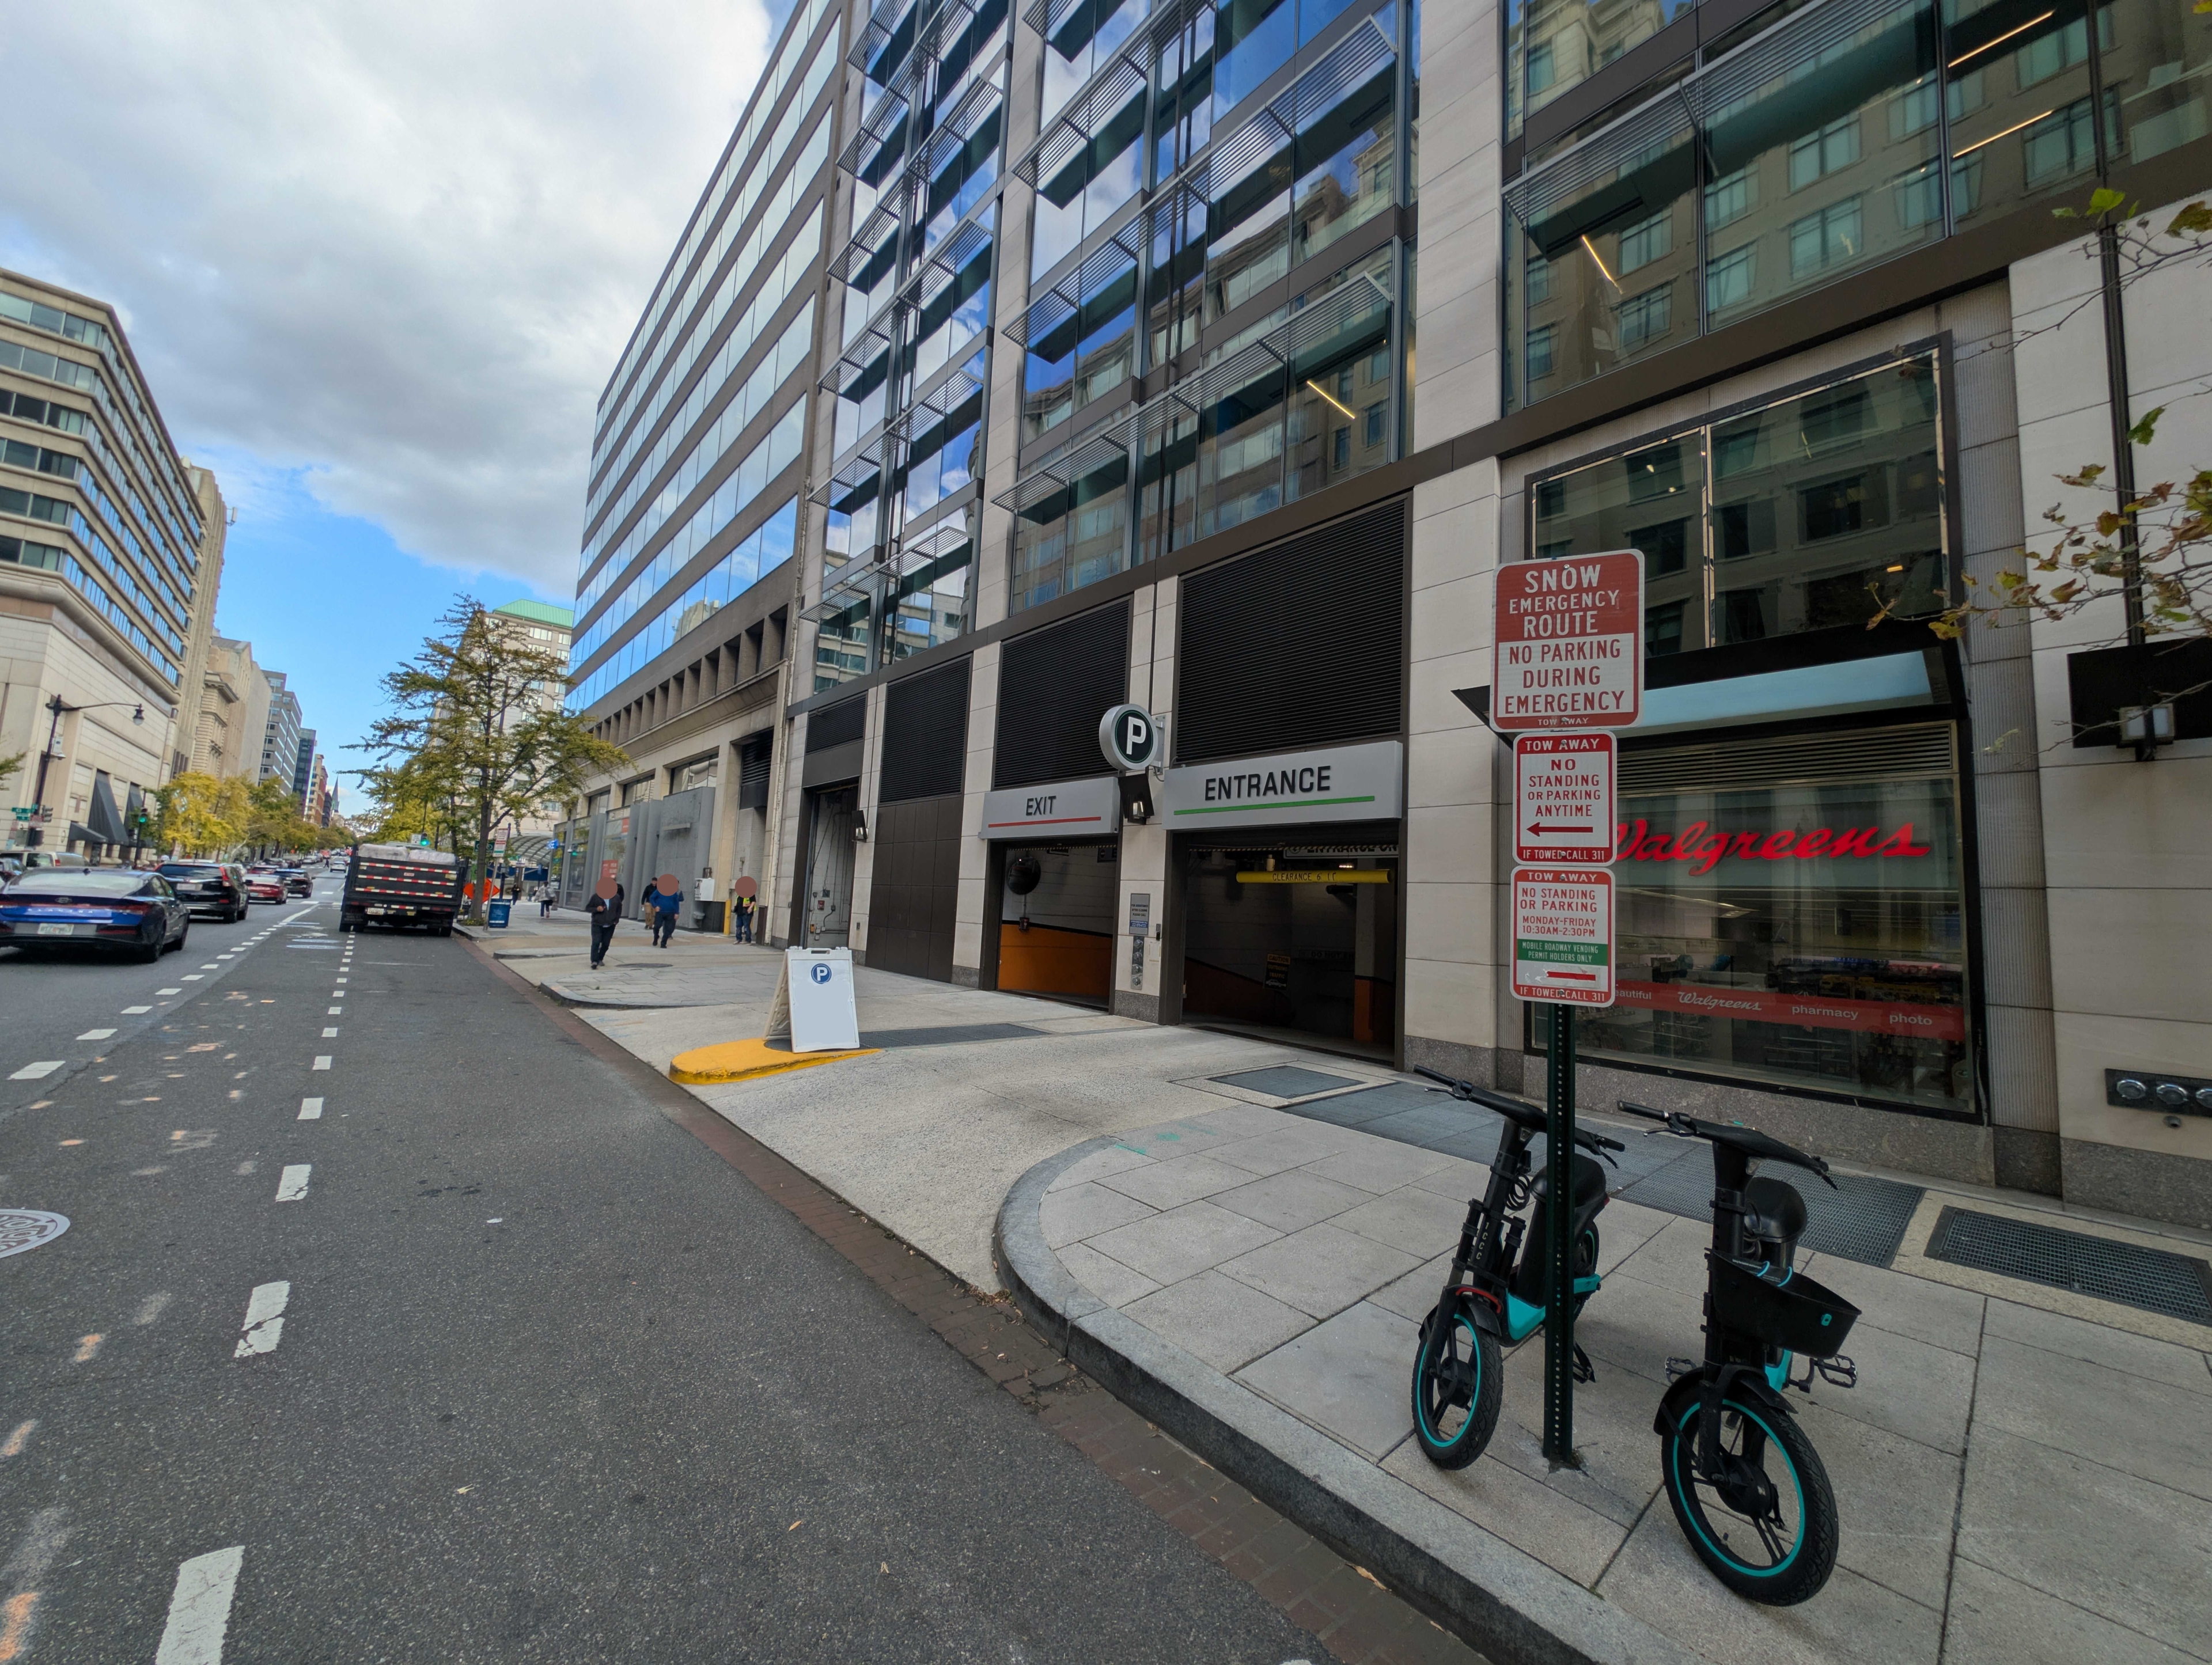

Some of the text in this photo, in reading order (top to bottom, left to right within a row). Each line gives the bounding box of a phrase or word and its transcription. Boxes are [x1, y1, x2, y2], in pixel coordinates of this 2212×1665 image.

[1525, 564, 1601, 593] SNOW
[1509, 590, 1619, 614] EMERGENCY
[1524, 610, 1598, 638] ROUTE
[1509, 639, 1620, 664] NO PARKING
[1523, 666, 1600, 688] DURING
[1505, 691, 1624, 714] EMERGENCY
[1126, 716, 1146, 755] P
[1525, 738, 1600, 751] TOW AWAY
[1551, 758, 1576, 771] NO
[1205, 765, 1332, 801] ENTRANCE
[1529, 775, 1599, 787] STANDING
[1528, 790, 1601, 801] OR PARKING
[1026, 795, 1056, 817] EXIT
[1535, 805, 1592, 817] ANYTIME
[1523, 849, 1605, 860] IF TOWED CALL 311
[1272, 873, 1312, 881] CLEARANCE
[1528, 872, 1597, 882] TOW AWAY
[1522, 888, 1595, 900] NO STANDING
[1520, 900, 1597, 913] OR PARKING
[1522, 915, 1596, 927] MONDAY-FRIDAY
[1522, 925, 1595, 937] 10:30AM-2:30PM
[1522, 941, 1599, 954] MOBILE ROADWAY VENDING
[1528, 951, 1592, 962] PERMIT HOLDERS ONLY
[817, 967, 828, 981] P
[1520, 987, 1605, 1002] IF TOWED CALL 311
[1615, 990, 1933, 1025] eautiful Walgreens pharmacy photo
